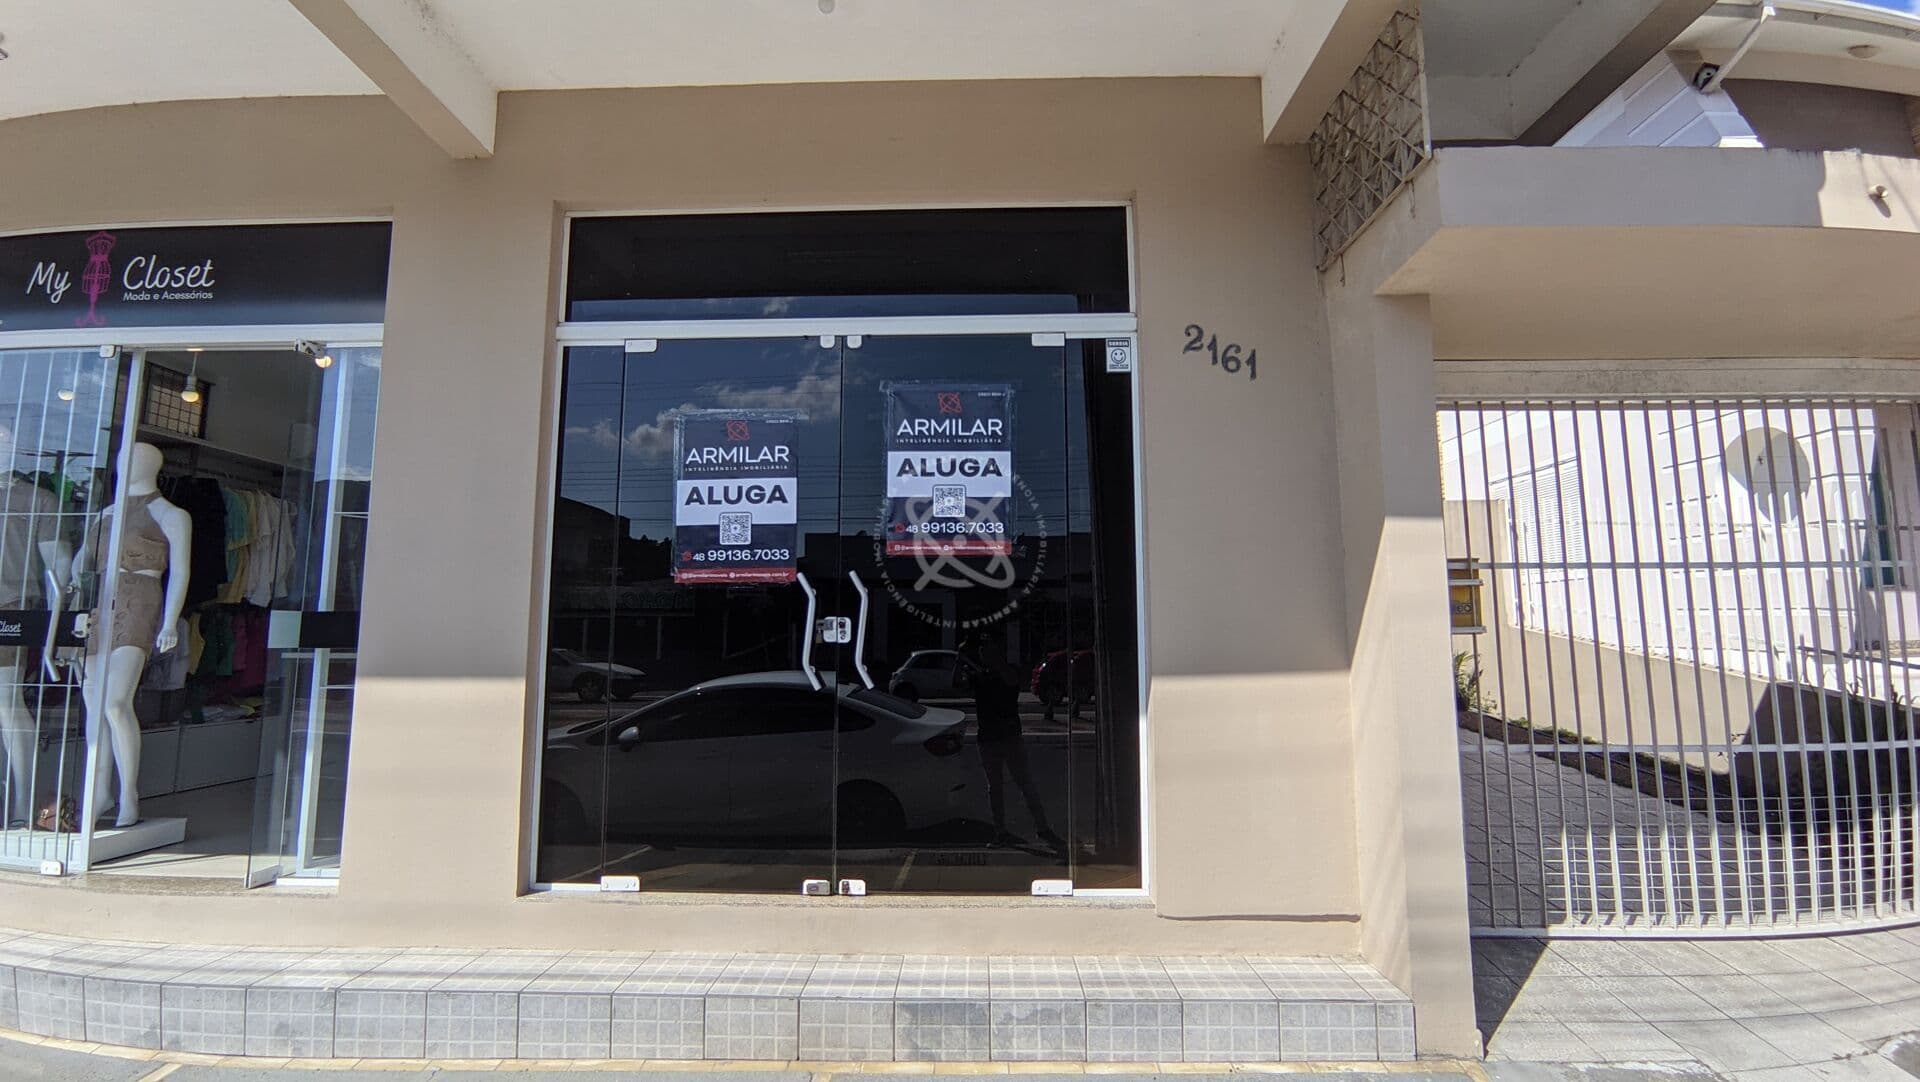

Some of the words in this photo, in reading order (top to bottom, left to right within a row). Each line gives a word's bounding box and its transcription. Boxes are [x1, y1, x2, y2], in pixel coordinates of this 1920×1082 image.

[26, 261, 72, 304] My
[123, 254, 215, 290] Closet
[123, 291, 151, 301] Moda
[162, 289, 213, 300] Acessórios
[1183, 323, 1257, 381] 2161
[896, 418, 1003, 437] ARMILAR
[685, 445, 790, 465] ARMILAR
[896, 457, 1003, 478] ALUGA
[684, 484, 789, 506] ALUGA
[905, 525, 919, 533] 48
[921, 522, 1005, 533] 99136.7033
[692, 553, 706, 562] 48
[708, 549, 790, 561] 99136.7033
